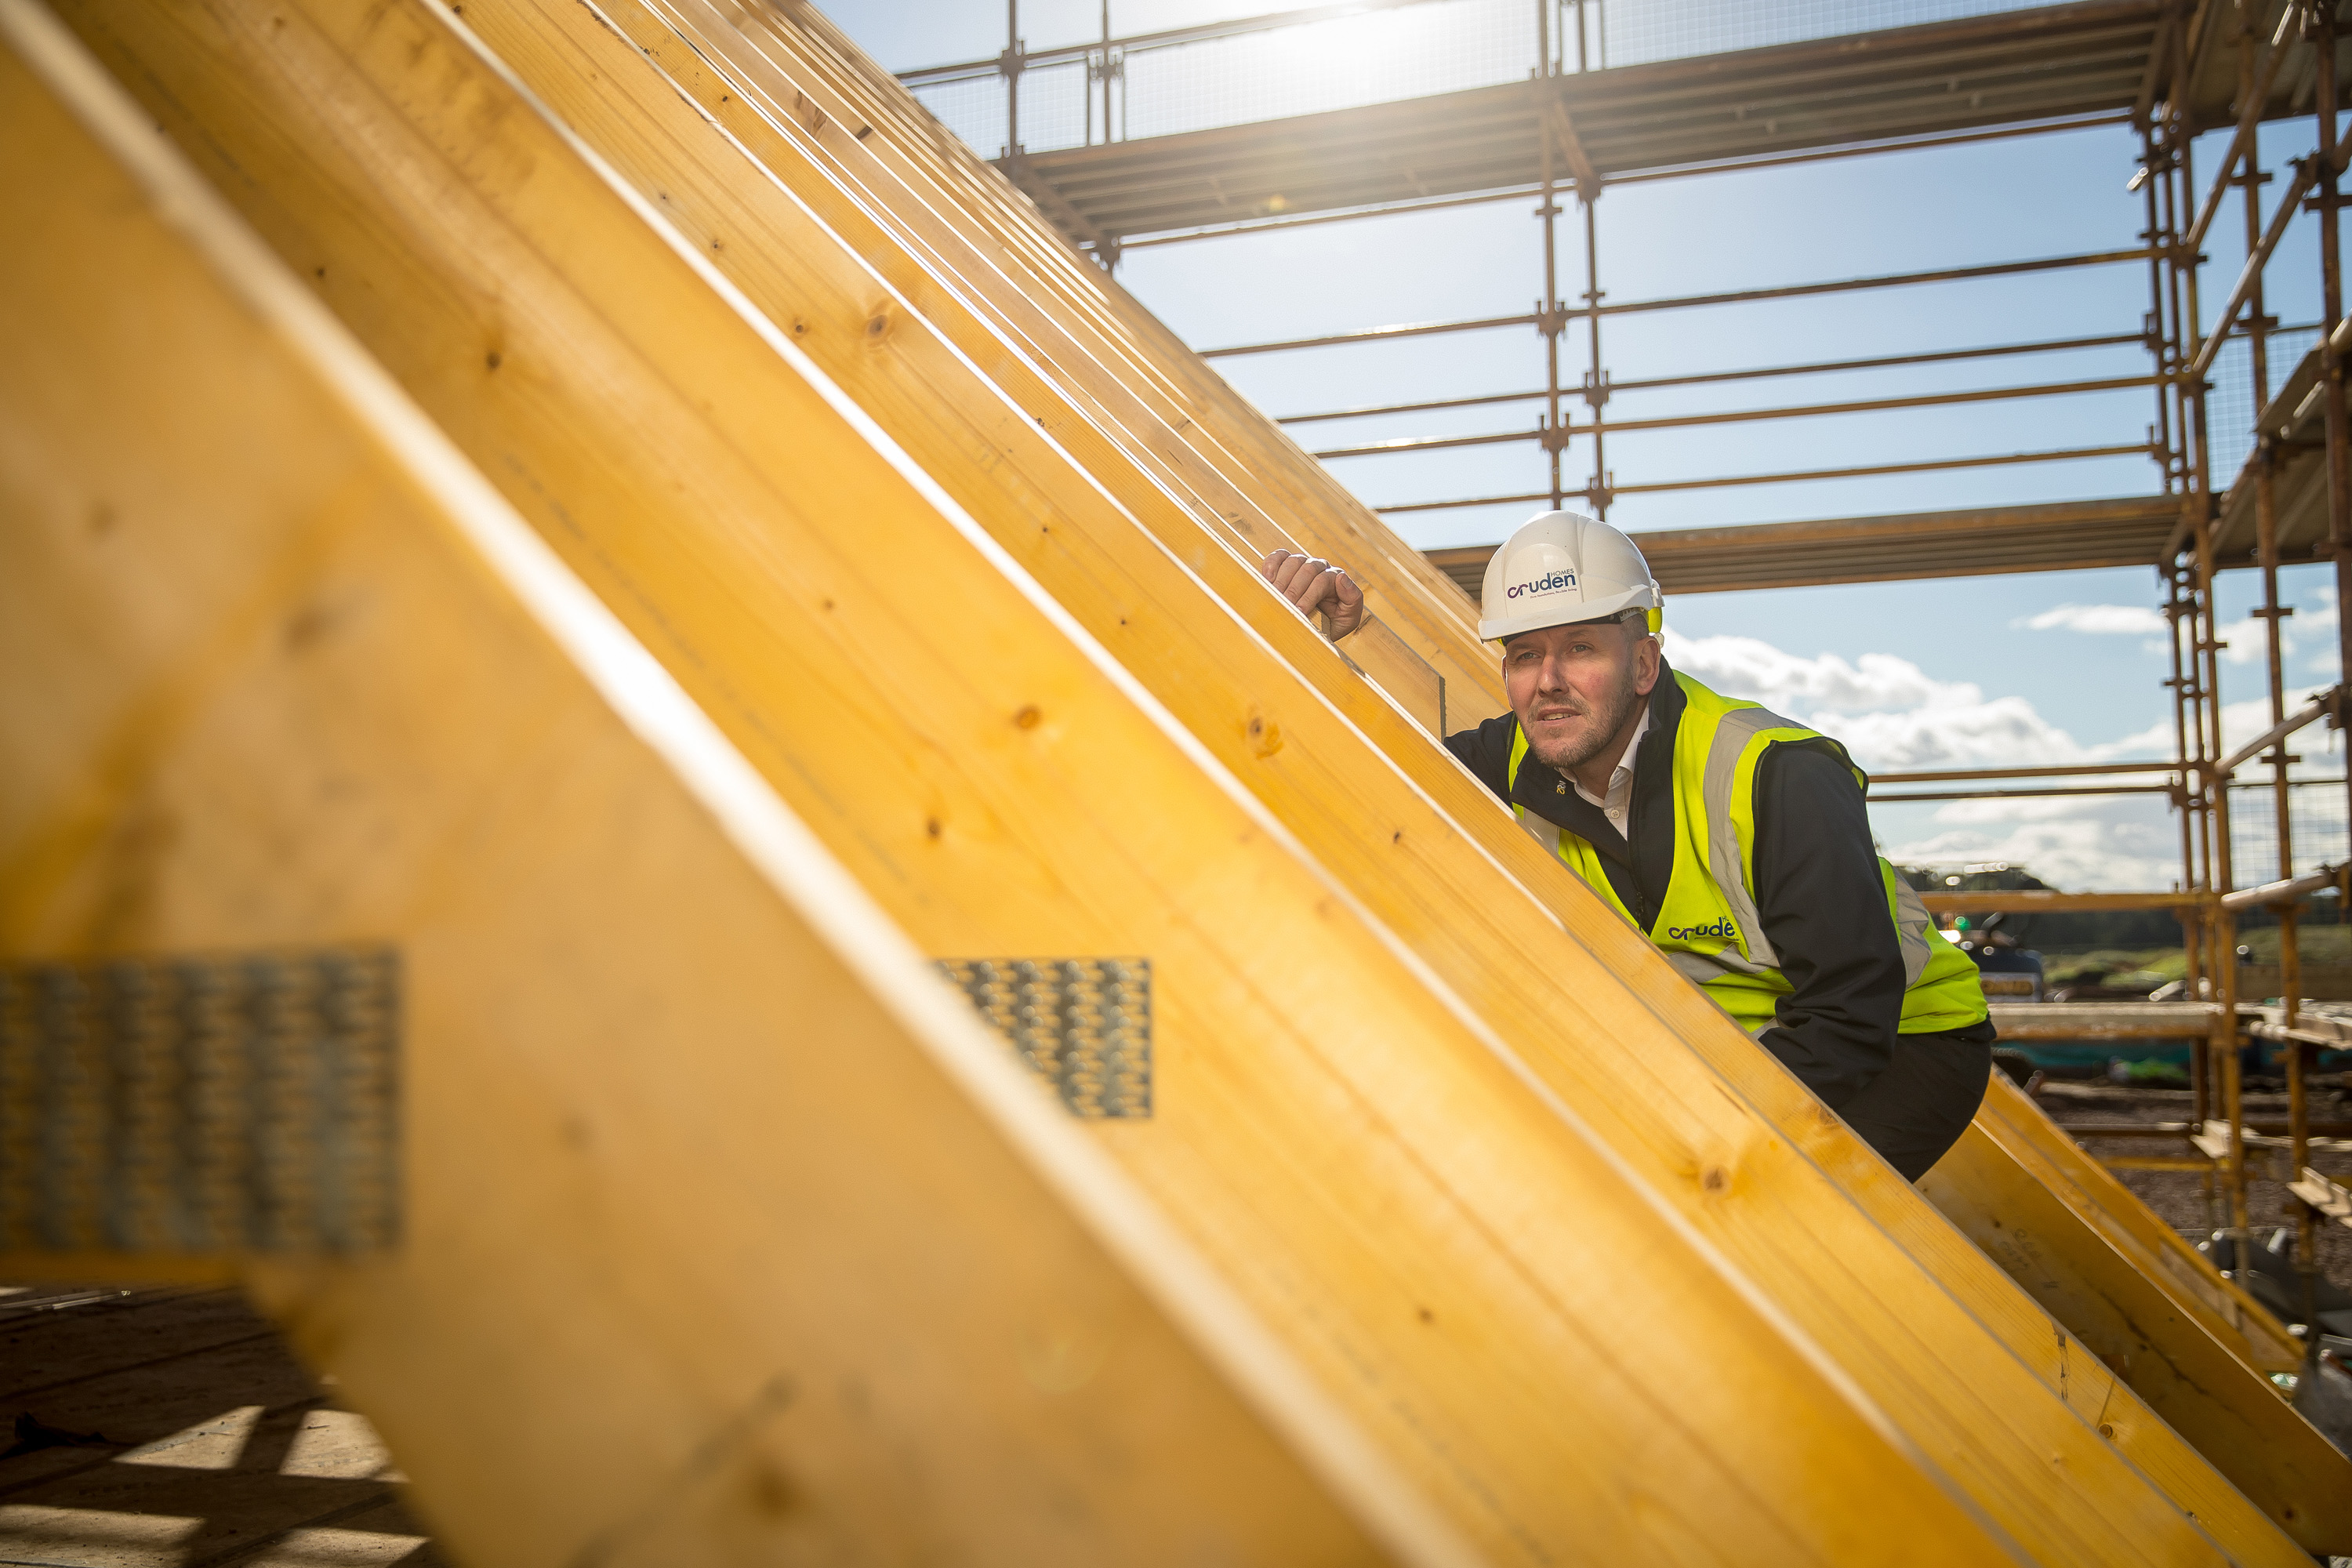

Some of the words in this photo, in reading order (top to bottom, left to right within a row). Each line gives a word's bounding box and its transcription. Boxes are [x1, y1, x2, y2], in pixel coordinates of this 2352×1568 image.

[1550, 568, 1574, 577] HOMES
[1507, 572, 1576, 599] cruden
[1668, 916, 1736, 941] crude
